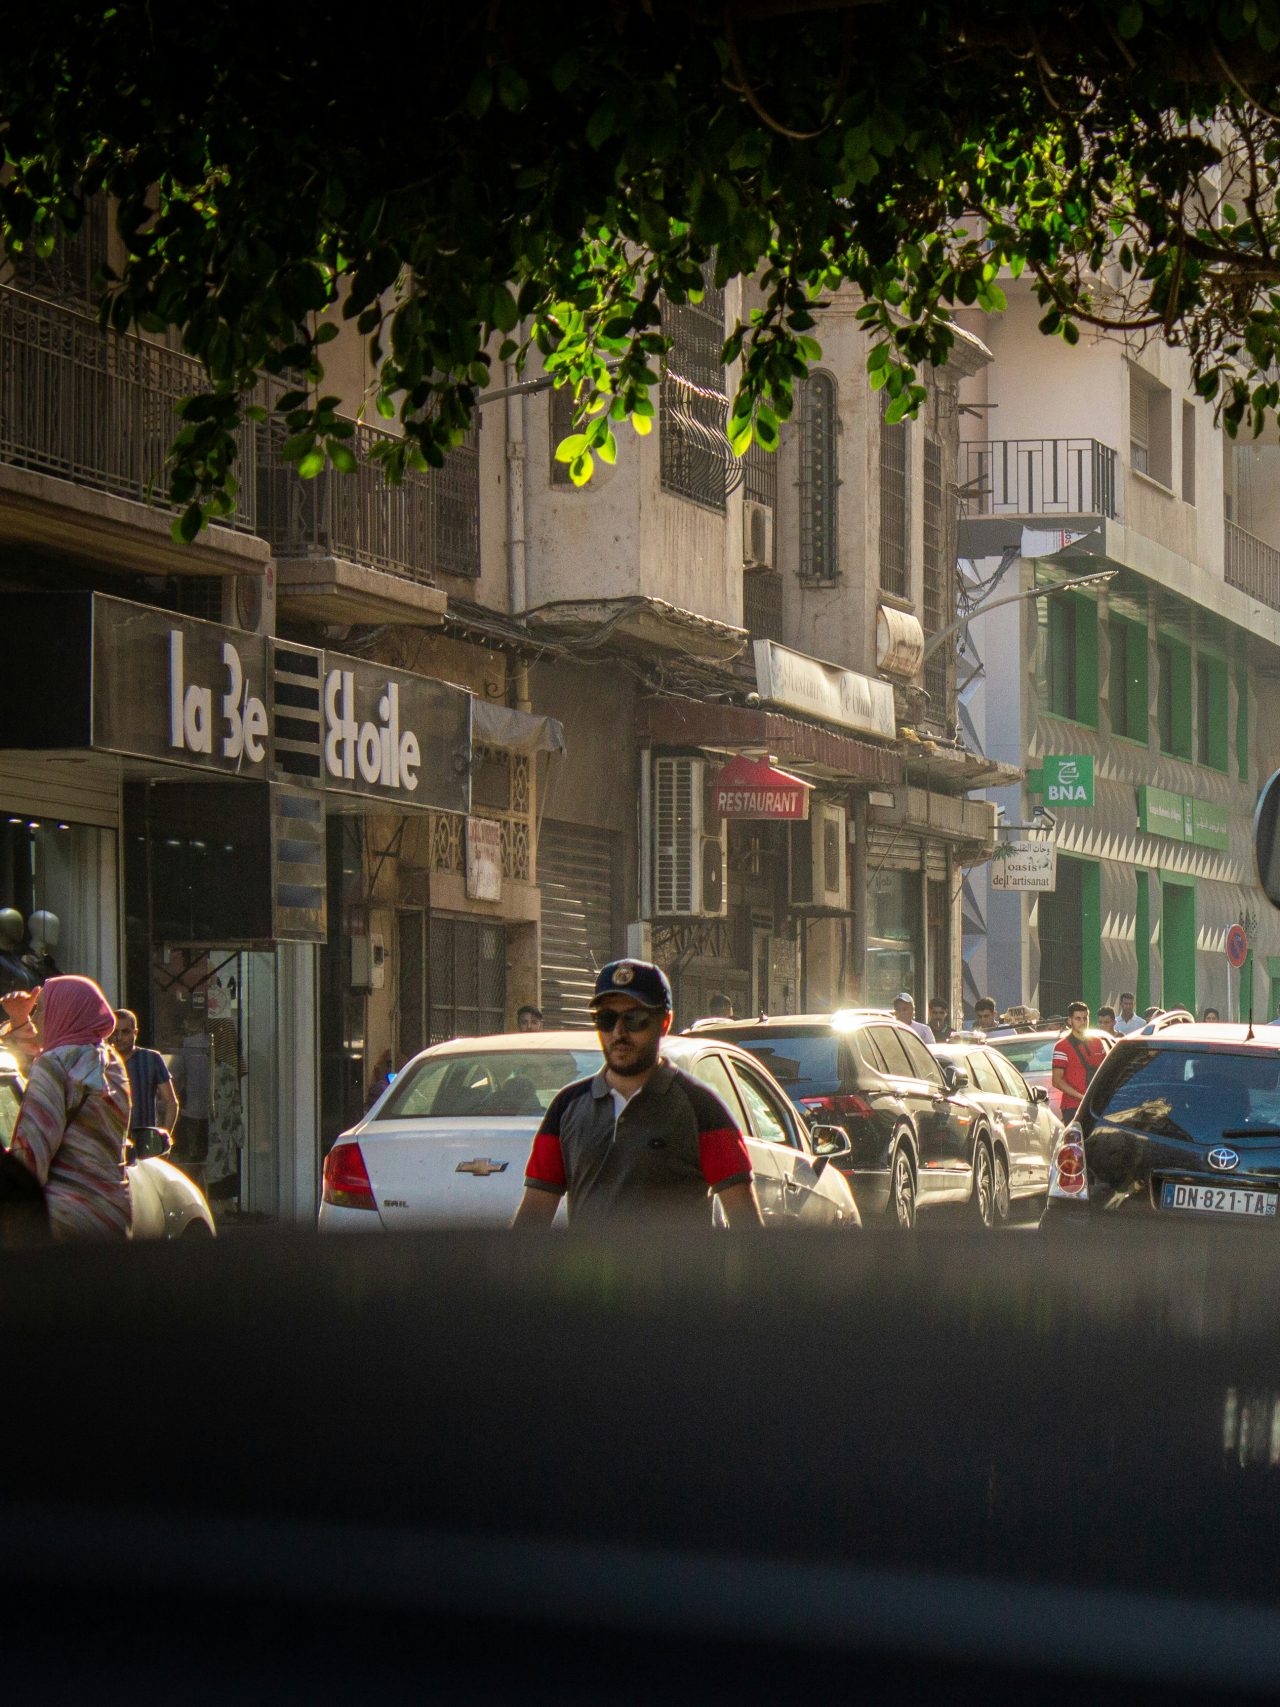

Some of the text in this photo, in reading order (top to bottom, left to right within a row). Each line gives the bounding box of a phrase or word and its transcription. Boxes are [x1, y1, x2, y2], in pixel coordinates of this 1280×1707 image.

[169, 630, 212, 753] la
[717, 791, 799, 813] RESTAURANT
[1048, 786, 1087, 801] BNA
[1007, 862, 1038, 872] oasis
[383, 1199, 410, 1208] SAIL
[1175, 1187, 1265, 1215] DN-821-TA
